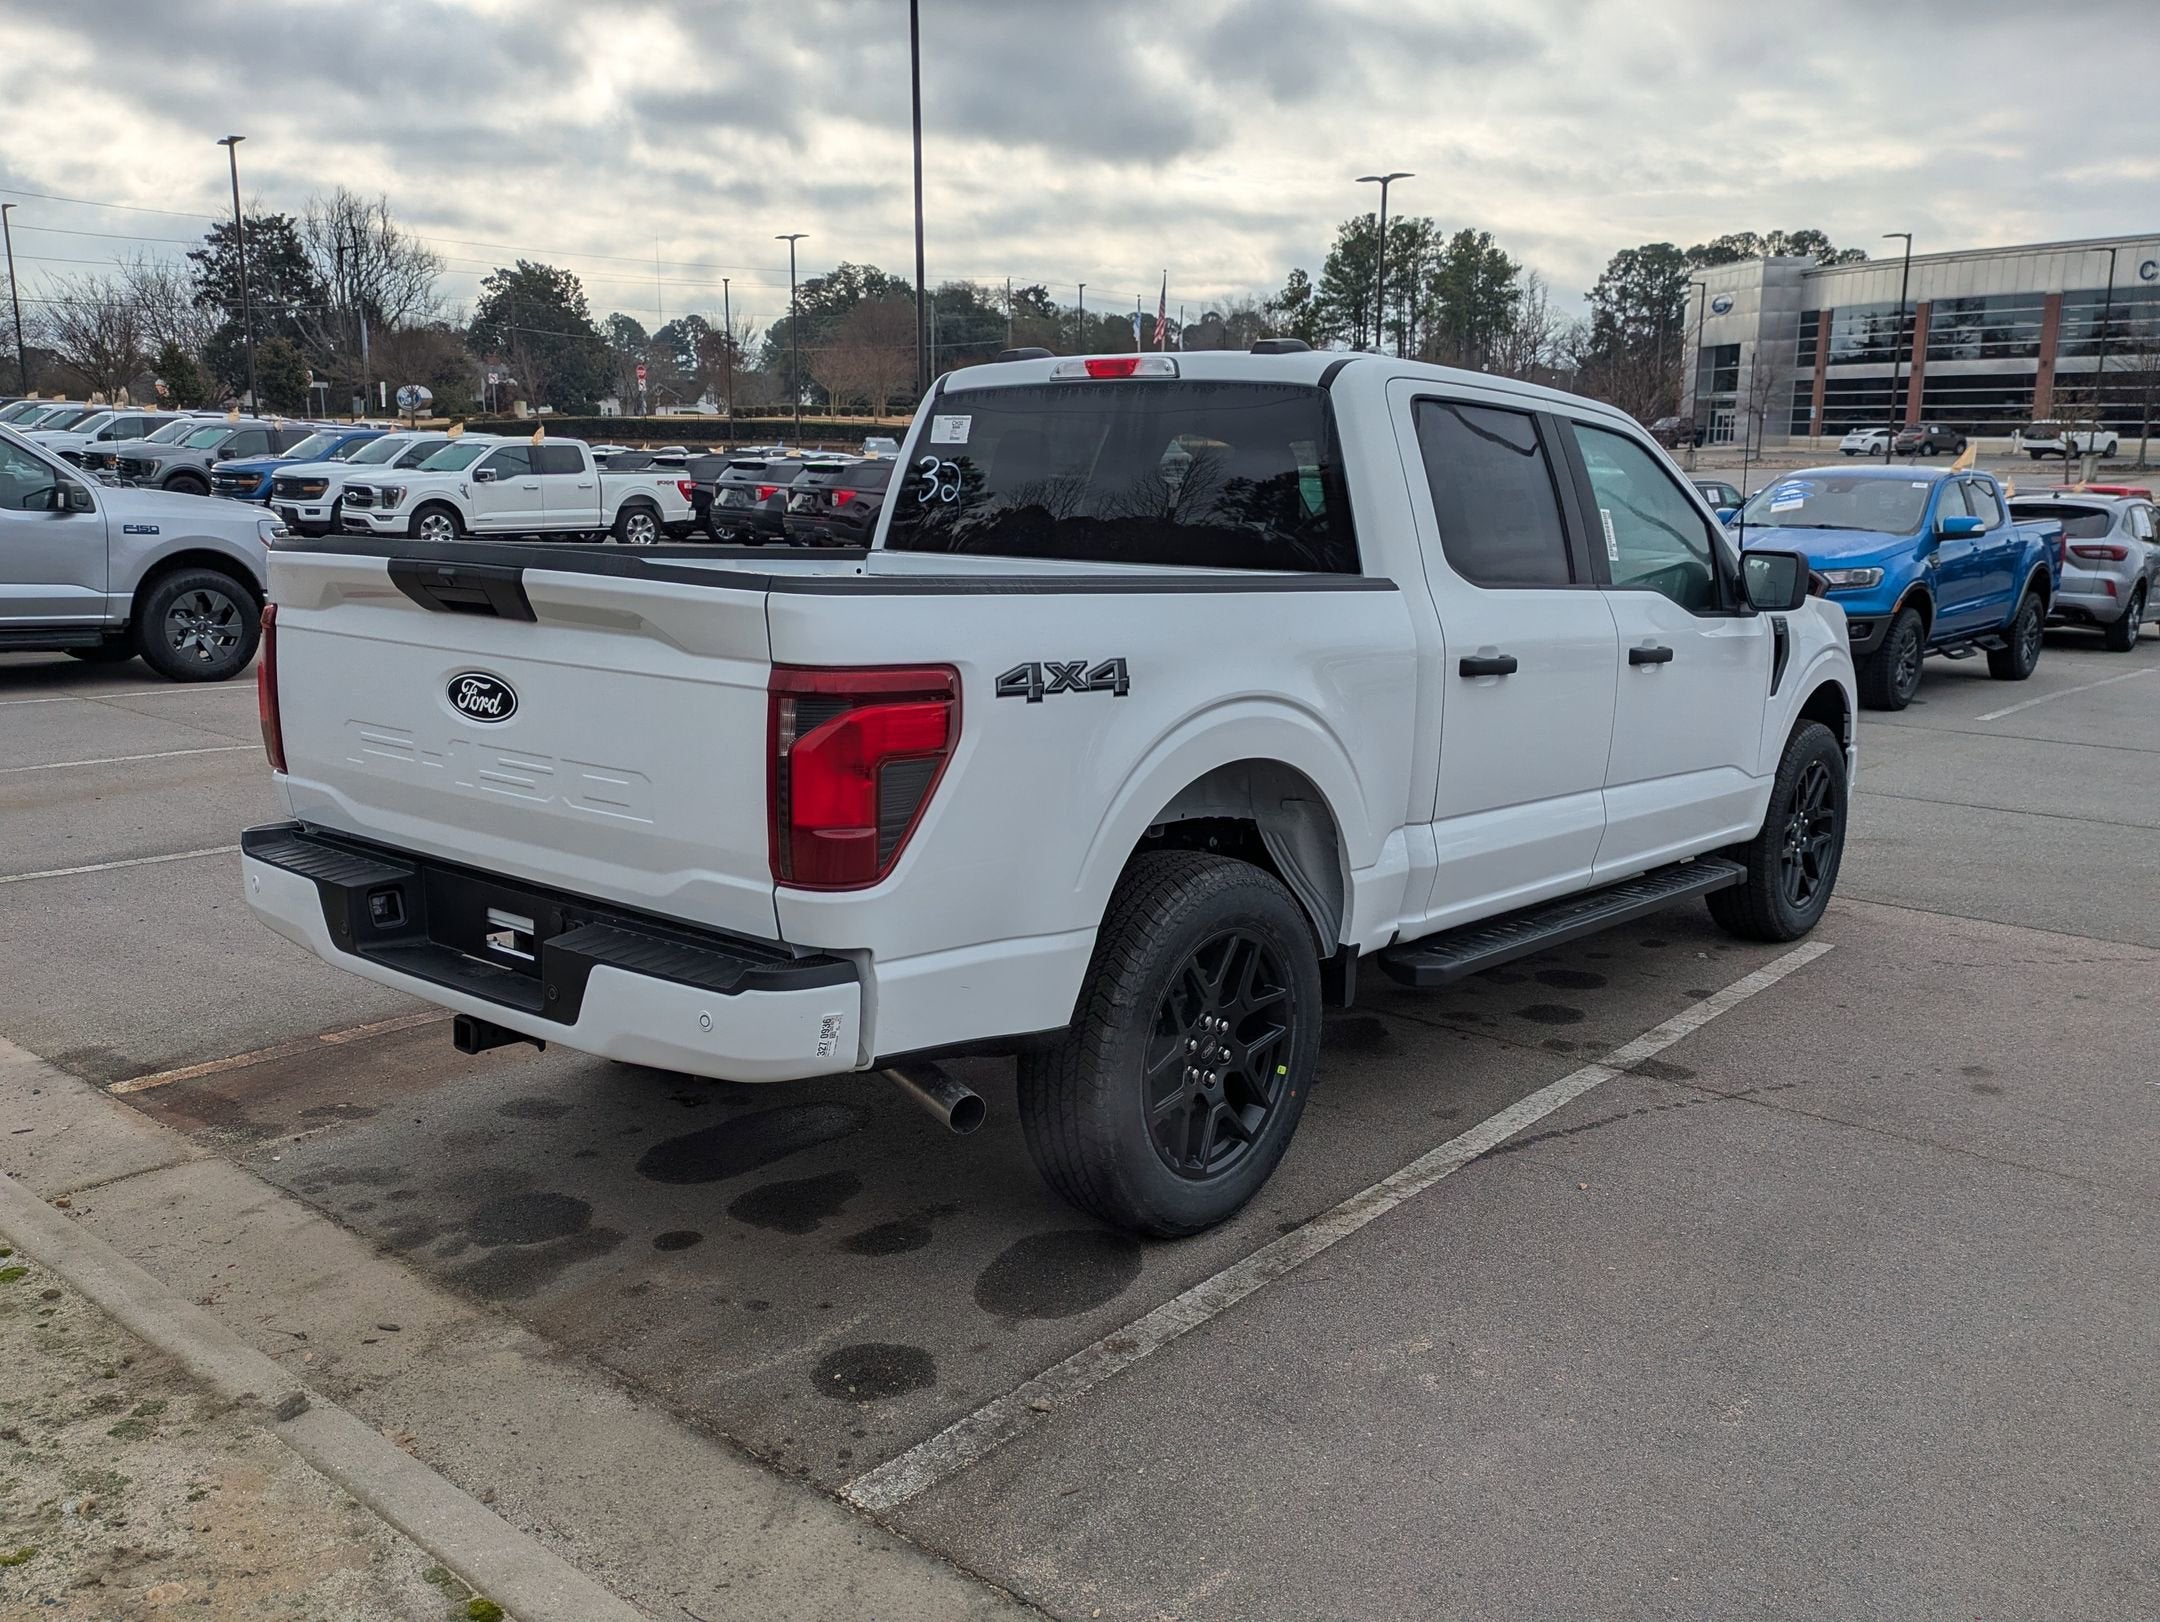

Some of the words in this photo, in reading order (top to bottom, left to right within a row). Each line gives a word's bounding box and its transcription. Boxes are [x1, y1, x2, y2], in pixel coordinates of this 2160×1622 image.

[918, 455, 962, 502] 32
[457, 678, 503, 715] Ford
[820, 1018, 832, 1039] 0936
[816, 1041, 828, 1057] 327
